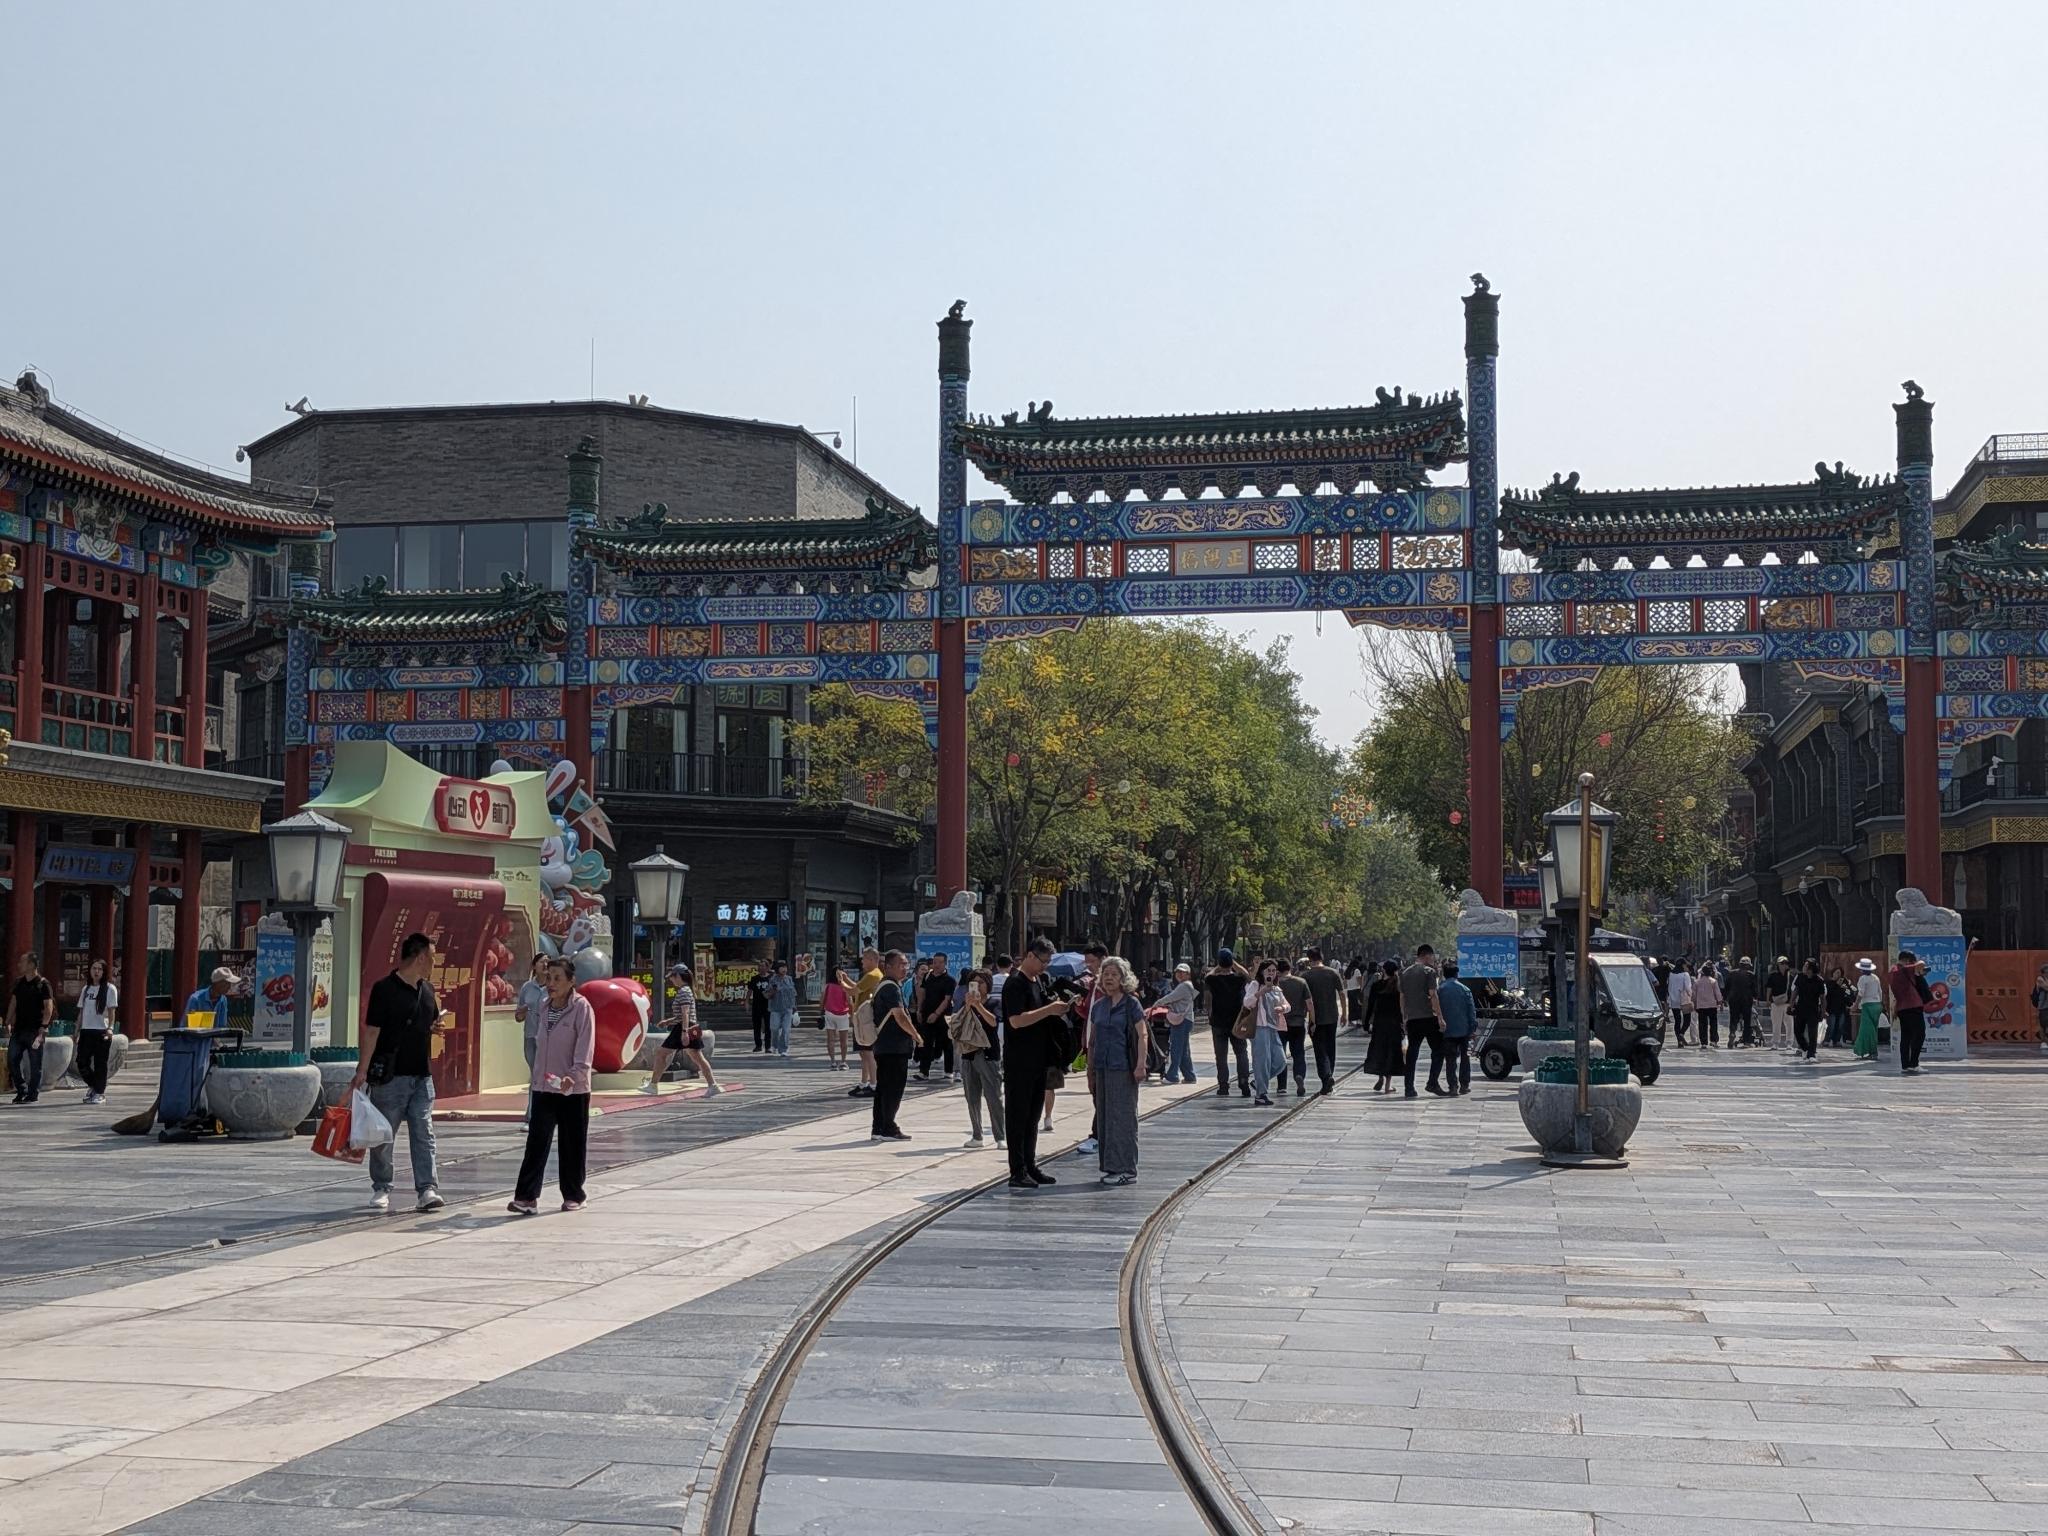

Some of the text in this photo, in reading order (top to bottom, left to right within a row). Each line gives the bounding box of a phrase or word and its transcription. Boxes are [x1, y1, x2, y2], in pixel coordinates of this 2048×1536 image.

[447, 795, 510, 825] 心动 前门
[717, 903, 768, 921] 面筋坊
